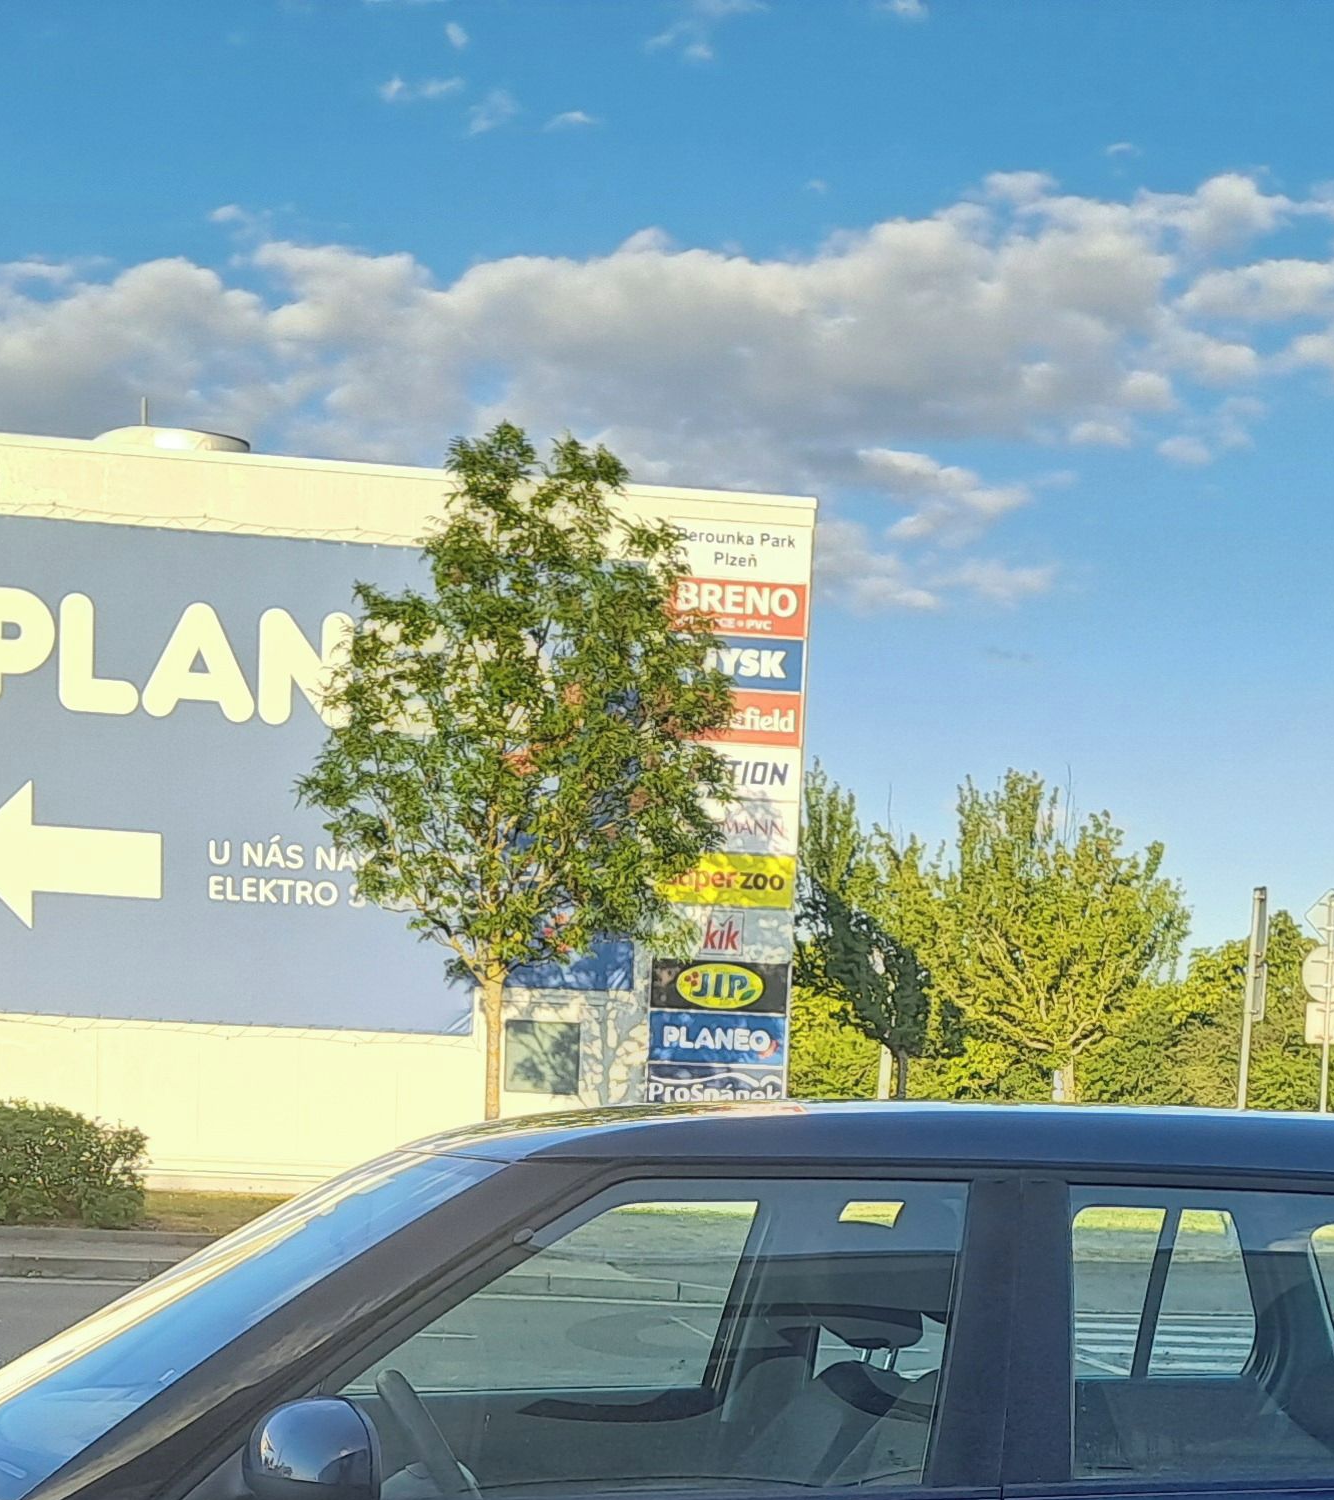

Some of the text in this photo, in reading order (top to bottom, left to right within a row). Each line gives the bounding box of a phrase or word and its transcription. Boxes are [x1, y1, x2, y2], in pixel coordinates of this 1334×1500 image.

[678, 527, 796, 549] Berounka Park
[713, 551, 758, 568] Plzeň
[676, 581, 798, 618] BRENO
[208, 839, 231, 866] U
[242, 835, 305, 871] NÁS
[208, 875, 339, 907] ELEKTRO
[690, 972, 749, 999] JIP
[662, 1025, 772, 1052] PLANEO
